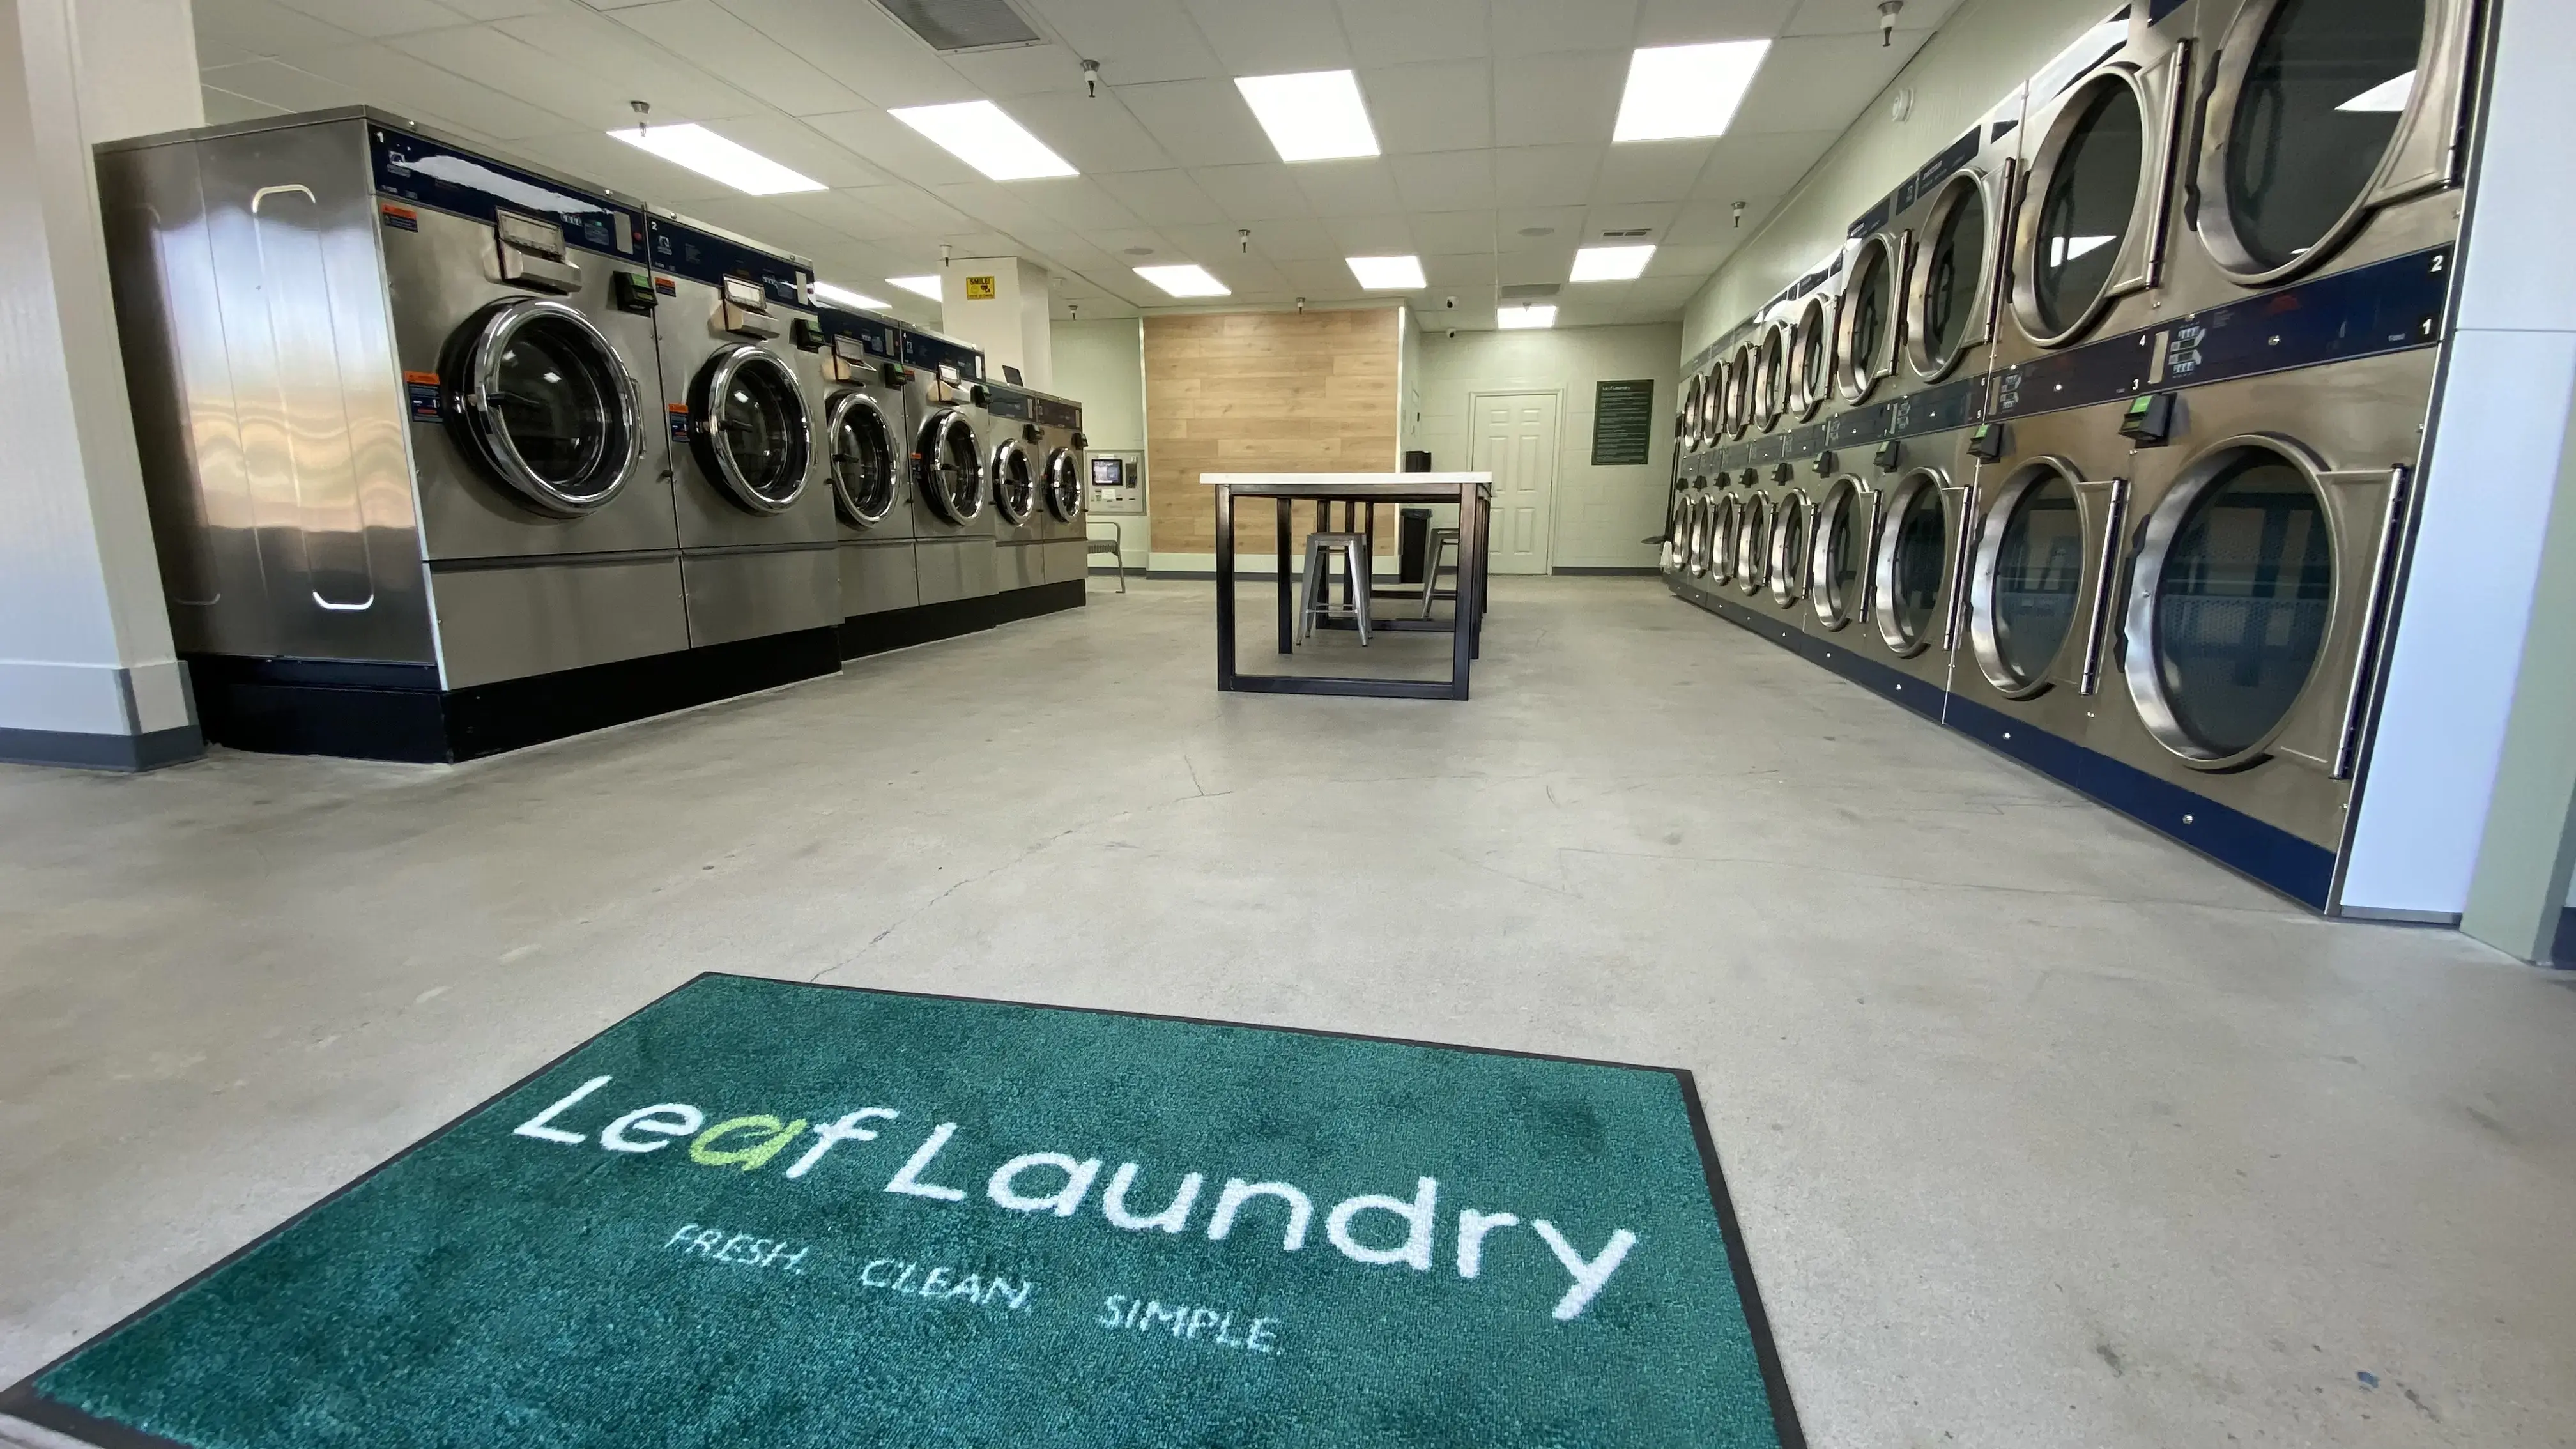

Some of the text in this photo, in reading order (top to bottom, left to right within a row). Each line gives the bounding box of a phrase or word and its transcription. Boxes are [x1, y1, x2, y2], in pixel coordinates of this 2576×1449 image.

[376, 132, 383, 143] 1
[652, 221, 657, 230] 2
[2430, 254, 2444, 272] 2
[2423, 318, 2432, 335] 1
[2139, 335, 2146, 346] 4
[2132, 378, 2139, 390] 3
[513, 1075, 1637, 1321] Leaf Laundry
[664, 1224, 809, 1275] FRESH.
[1101, 1294, 1281, 1354] SIMPLE.
